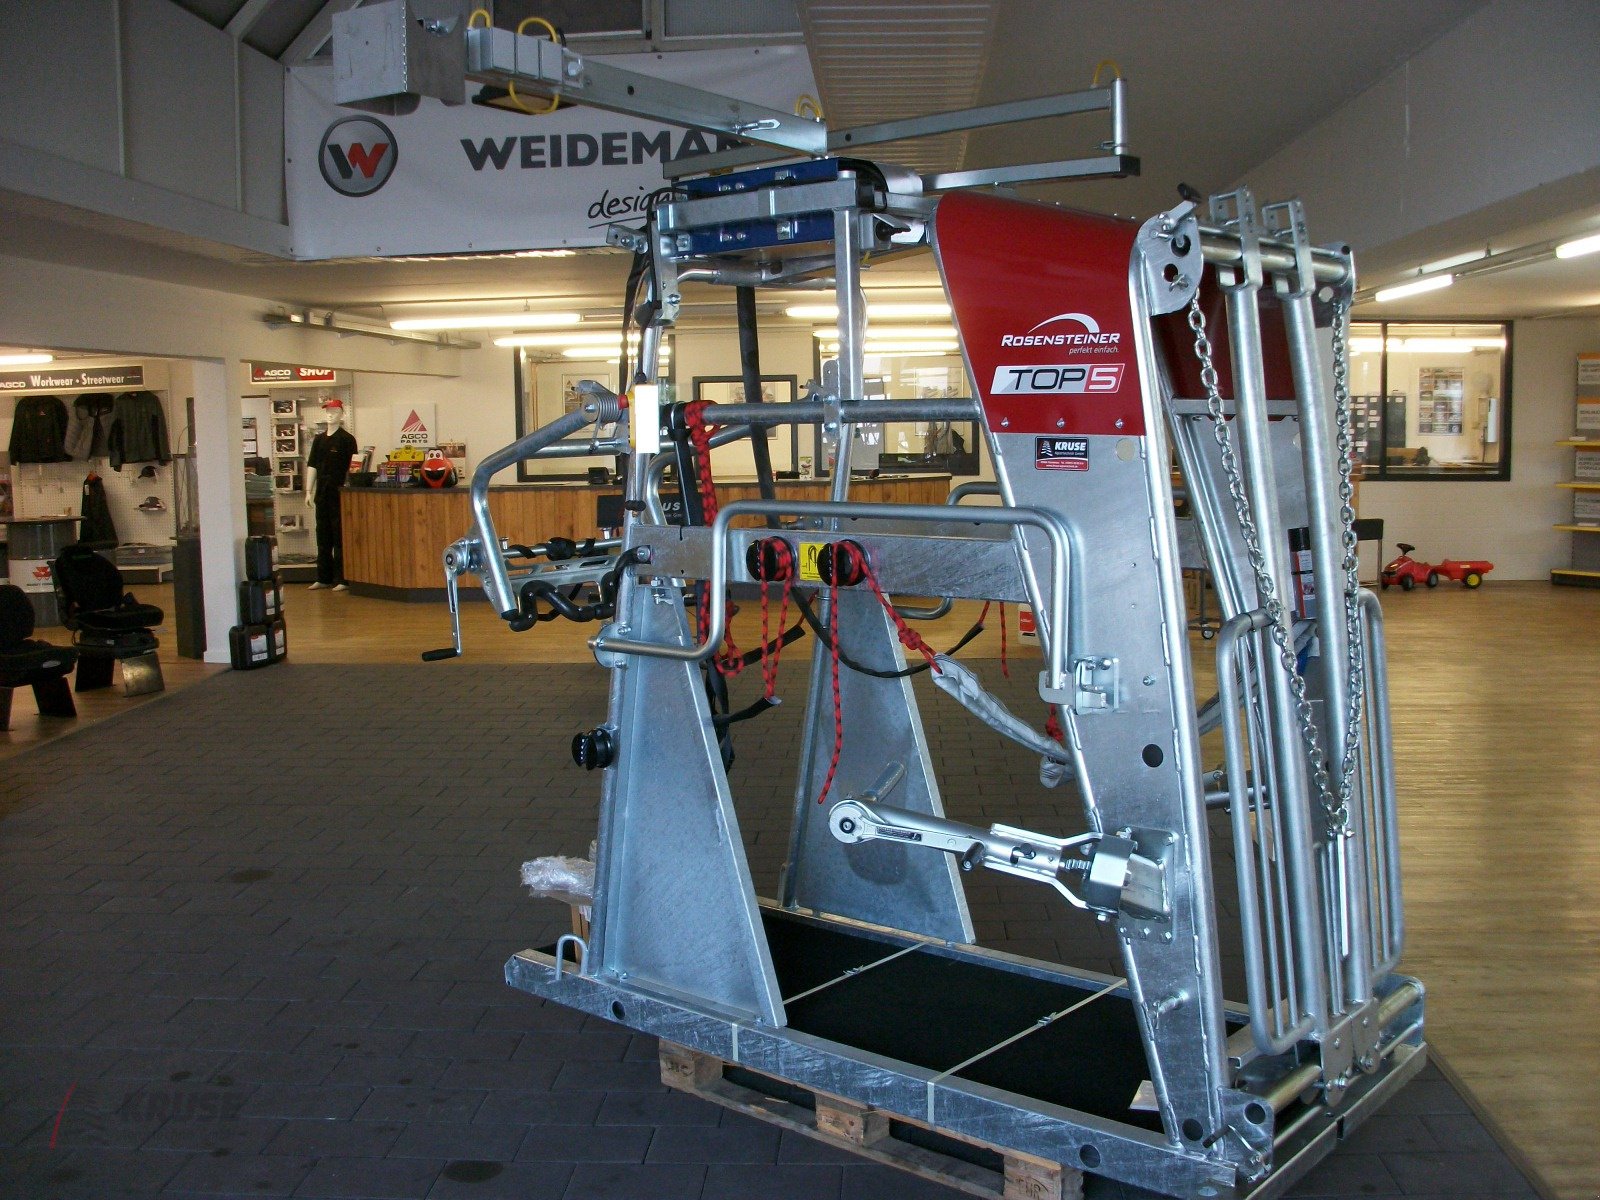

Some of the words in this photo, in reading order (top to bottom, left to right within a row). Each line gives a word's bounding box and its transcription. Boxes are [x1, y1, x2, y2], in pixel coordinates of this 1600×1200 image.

[1002, 333, 1120, 346] ROSENSTEINER
[1069, 346, 1093, 355] perfekt
[30, 375, 73, 388] Workwear
[81, 372, 125, 386] Streetwear
[1055, 441, 1086, 451] KRUSE
